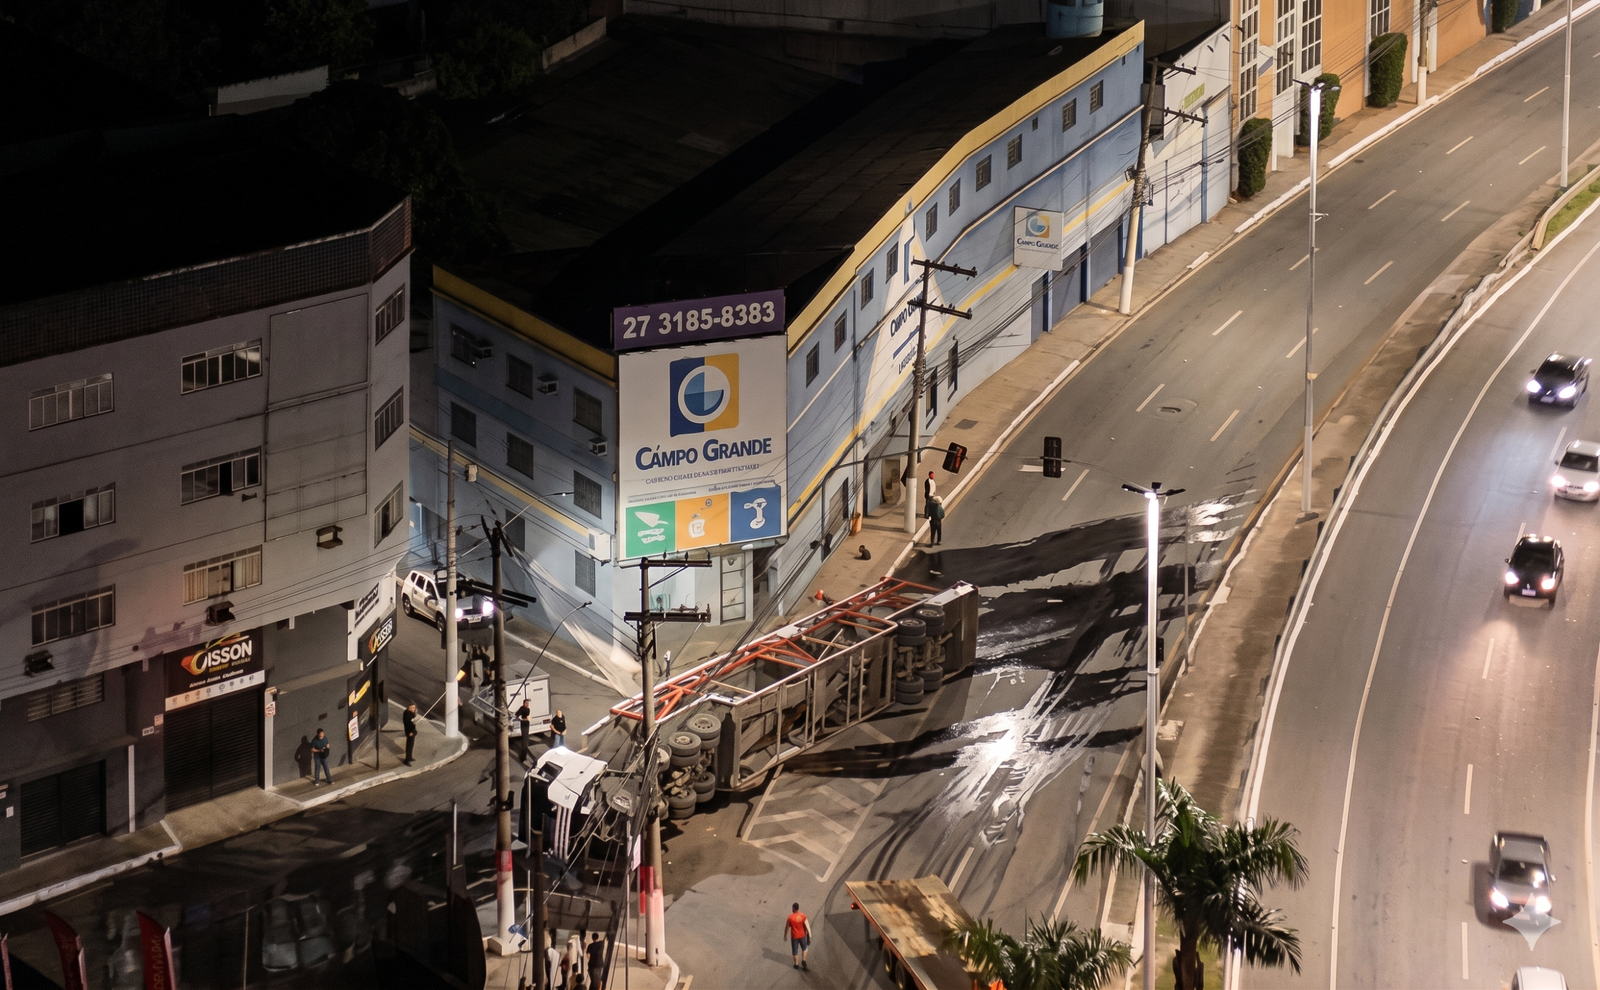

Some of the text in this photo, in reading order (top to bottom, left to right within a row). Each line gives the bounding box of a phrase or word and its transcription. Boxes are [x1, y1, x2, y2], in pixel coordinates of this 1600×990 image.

[622, 301, 775, 339] 27 3185-8383
[703, 437, 772, 462] GRANDE
